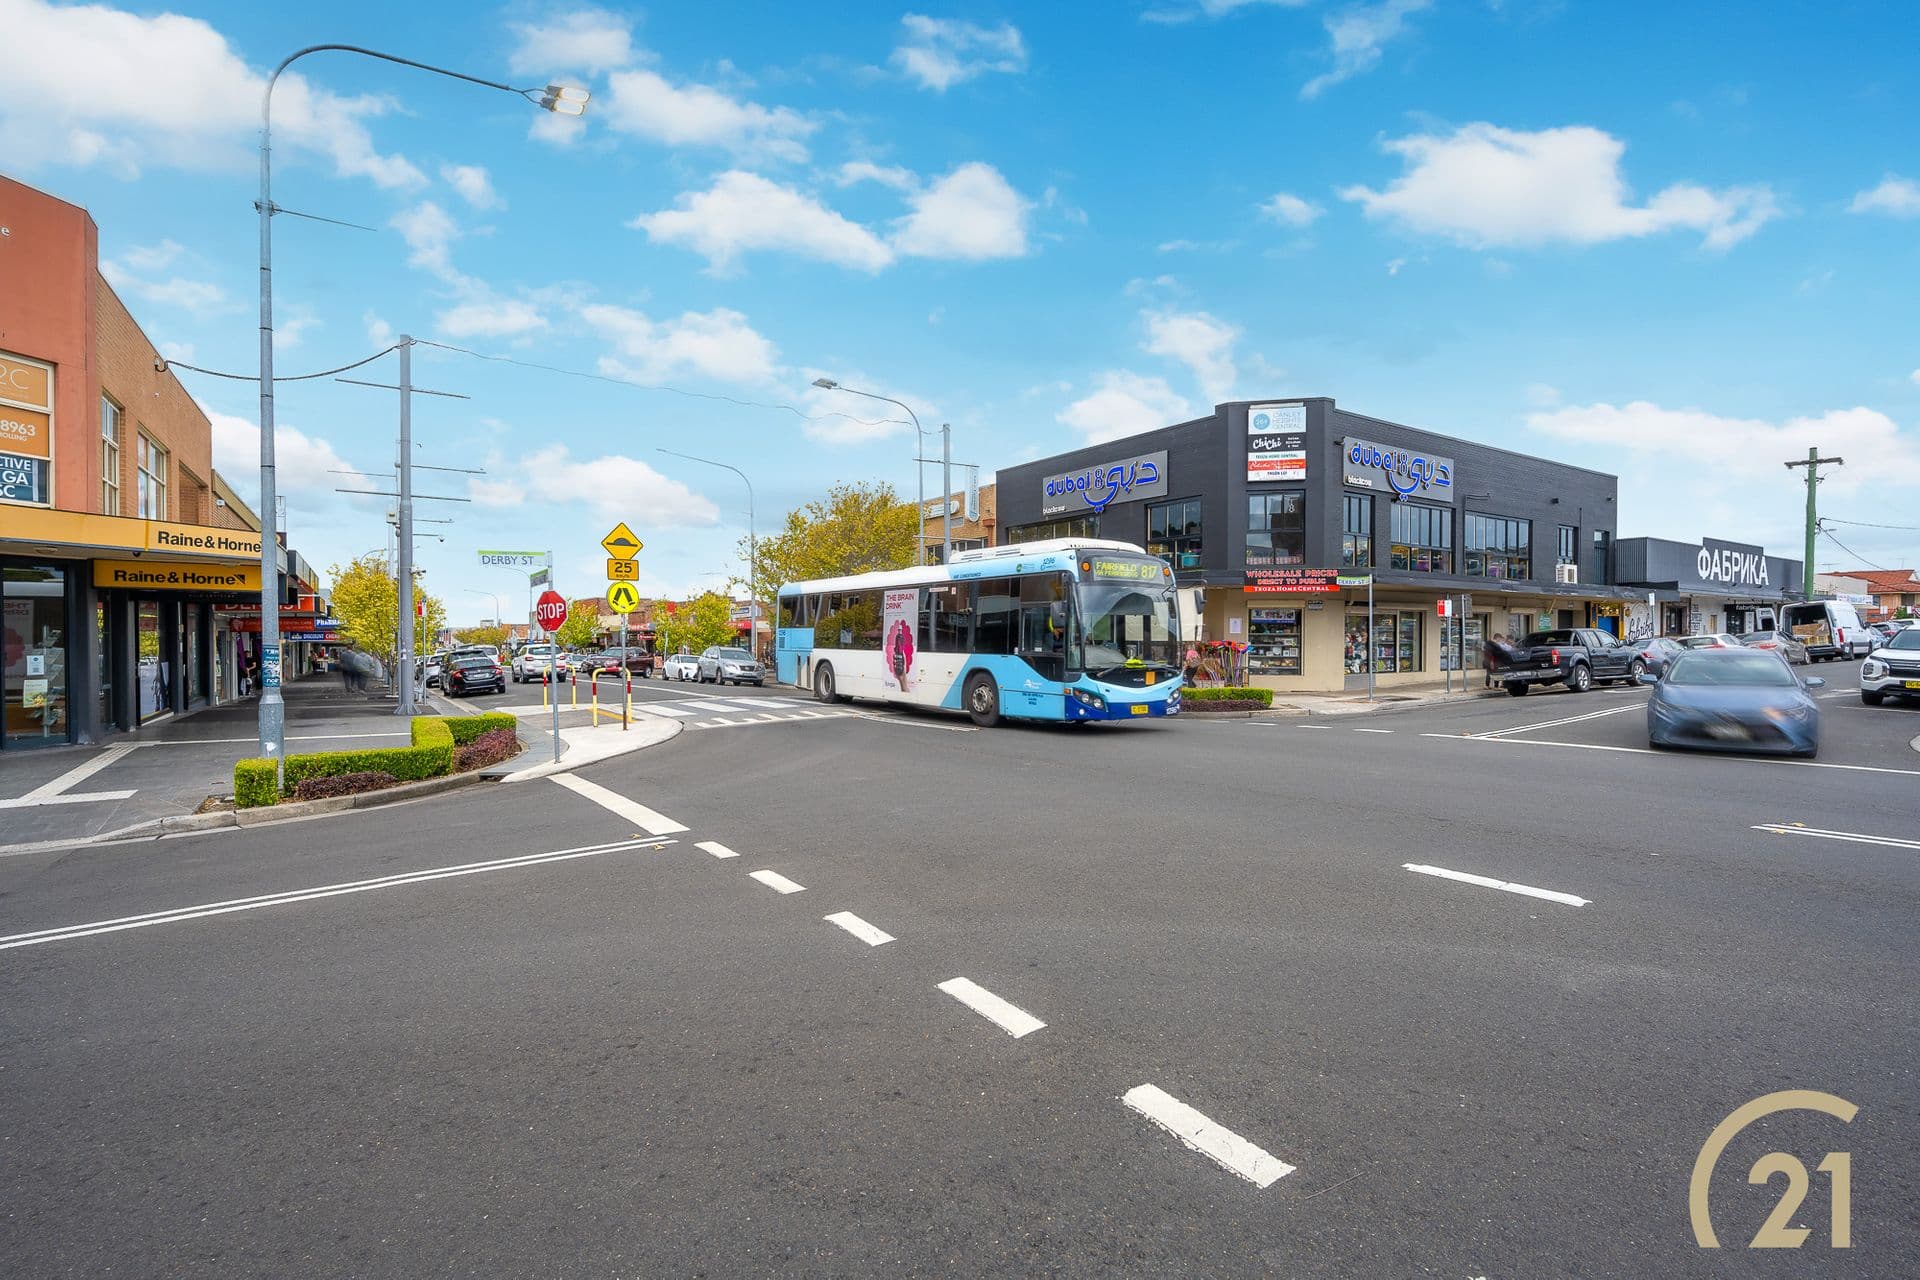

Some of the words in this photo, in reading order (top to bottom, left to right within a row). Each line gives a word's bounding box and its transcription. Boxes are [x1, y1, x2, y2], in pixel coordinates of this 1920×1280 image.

[1351, 442, 1397, 472] dubai
[2, 470, 28, 485] GA
[1045, 472, 1091, 497] dubai
[157, 530, 203, 548] Raine
[204, 535, 215, 549] &
[217, 536, 261, 553] Horne
[482, 555, 518, 566] DERBY
[521, 555, 534, 566] ST
[614, 561, 633, 574] 25
[1697, 547, 1770, 586] ФАБРИКА
[113, 569, 166, 584] Raine
[167, 571, 179, 584] &
[183, 571, 236, 585] Horne
[1141, 565, 1158, 578] 817
[1245, 569, 1302, 578] WHOLESALE
[1304, 568, 1339, 577] PRICES
[1298, 577, 1327, 585] PUBLIC
[885, 593, 897, 602] THE
[897, 592, 915, 602] BRAIN
[537, 602, 565, 621] STOP
[885, 601, 903, 610] DRINK
